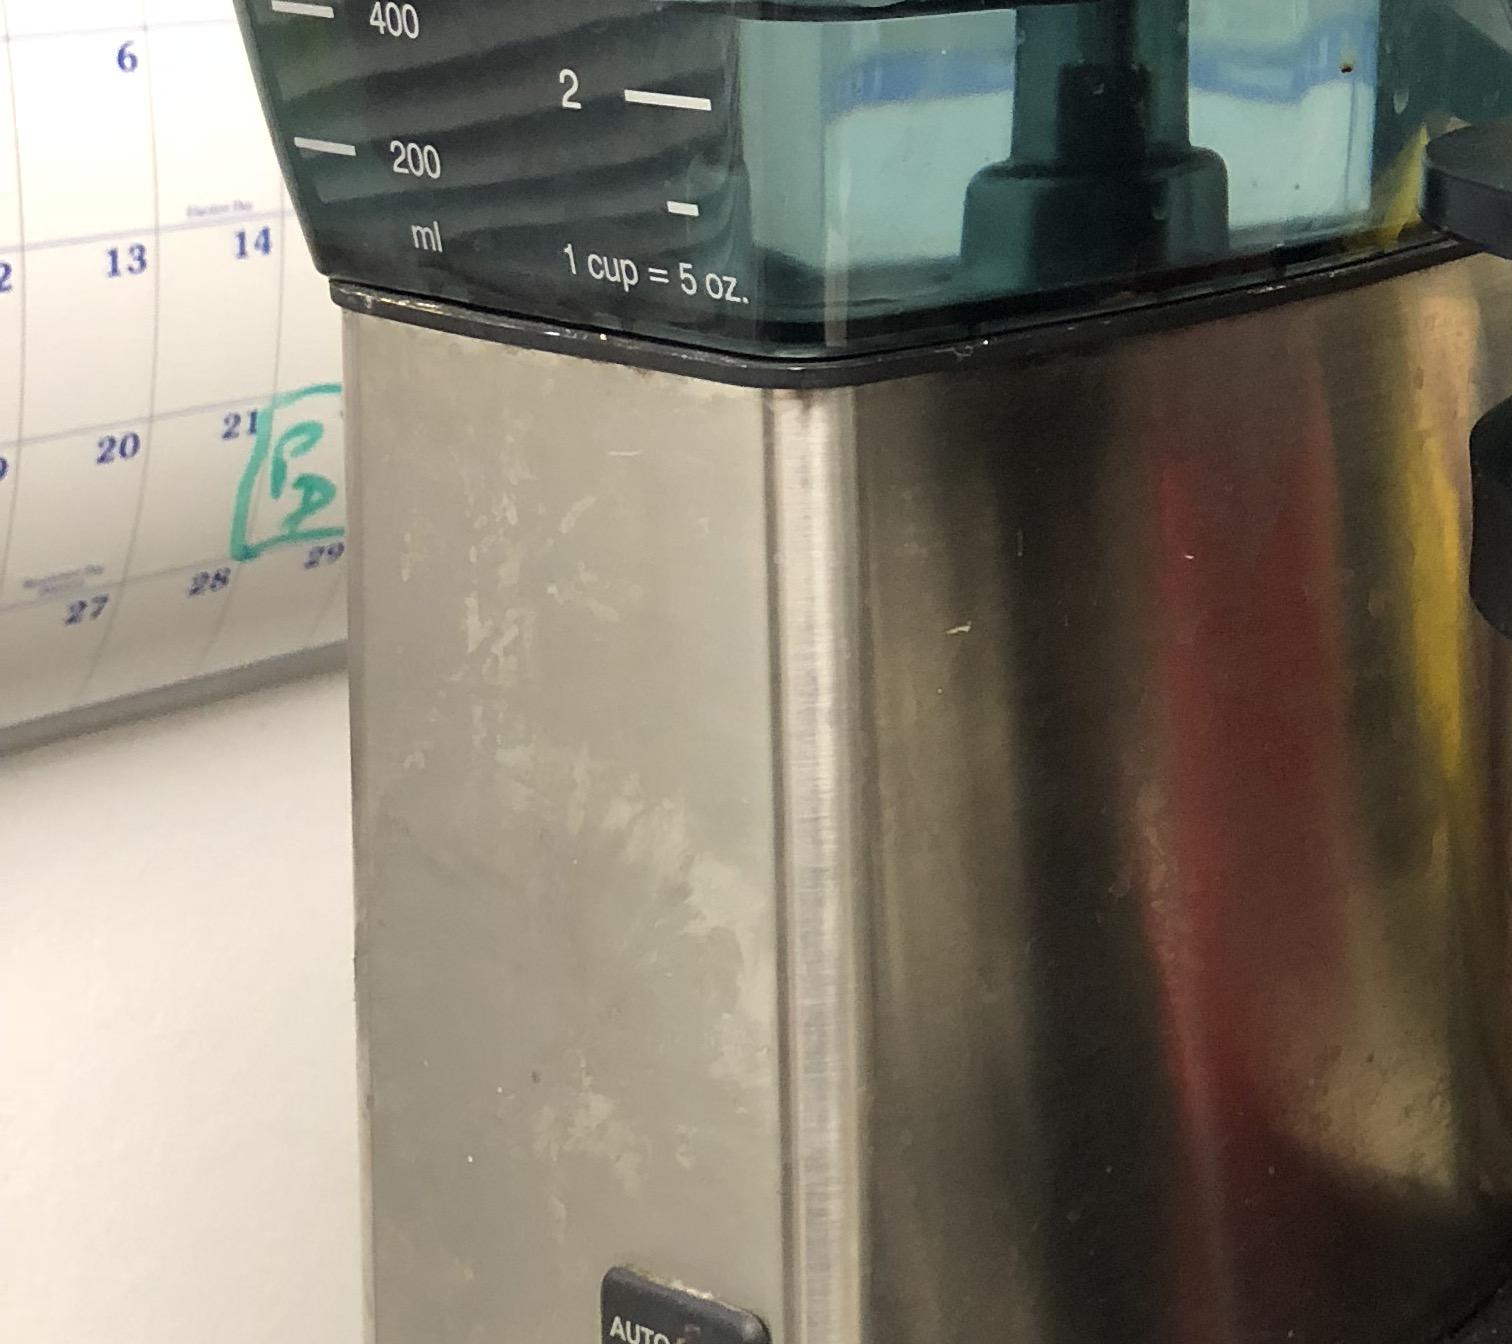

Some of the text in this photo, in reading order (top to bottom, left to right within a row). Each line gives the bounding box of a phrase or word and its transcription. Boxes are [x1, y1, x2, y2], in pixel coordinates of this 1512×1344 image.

[368, 0, 420, 40] 400
[116, 40, 139, 74] 6
[558, 67, 583, 111] 2
[389, 139, 442, 180] 200
[234, 224, 273, 260] 14
[411, 220, 444, 254] ml
[105, 241, 148, 279] 13
[563, 243, 578, 276] 1
[587, 253, 639, 293] cup
[678, 262, 698, 297] 5
[704, 270, 750, 306] oz.
[0, 261, 13, 294] 2
[221, 408, 259, 441] 21
[96, 431, 141, 465] 20
[303, 540, 345, 570] 29
[186, 567, 231, 598] 28
[64, 592, 109, 626] 27
